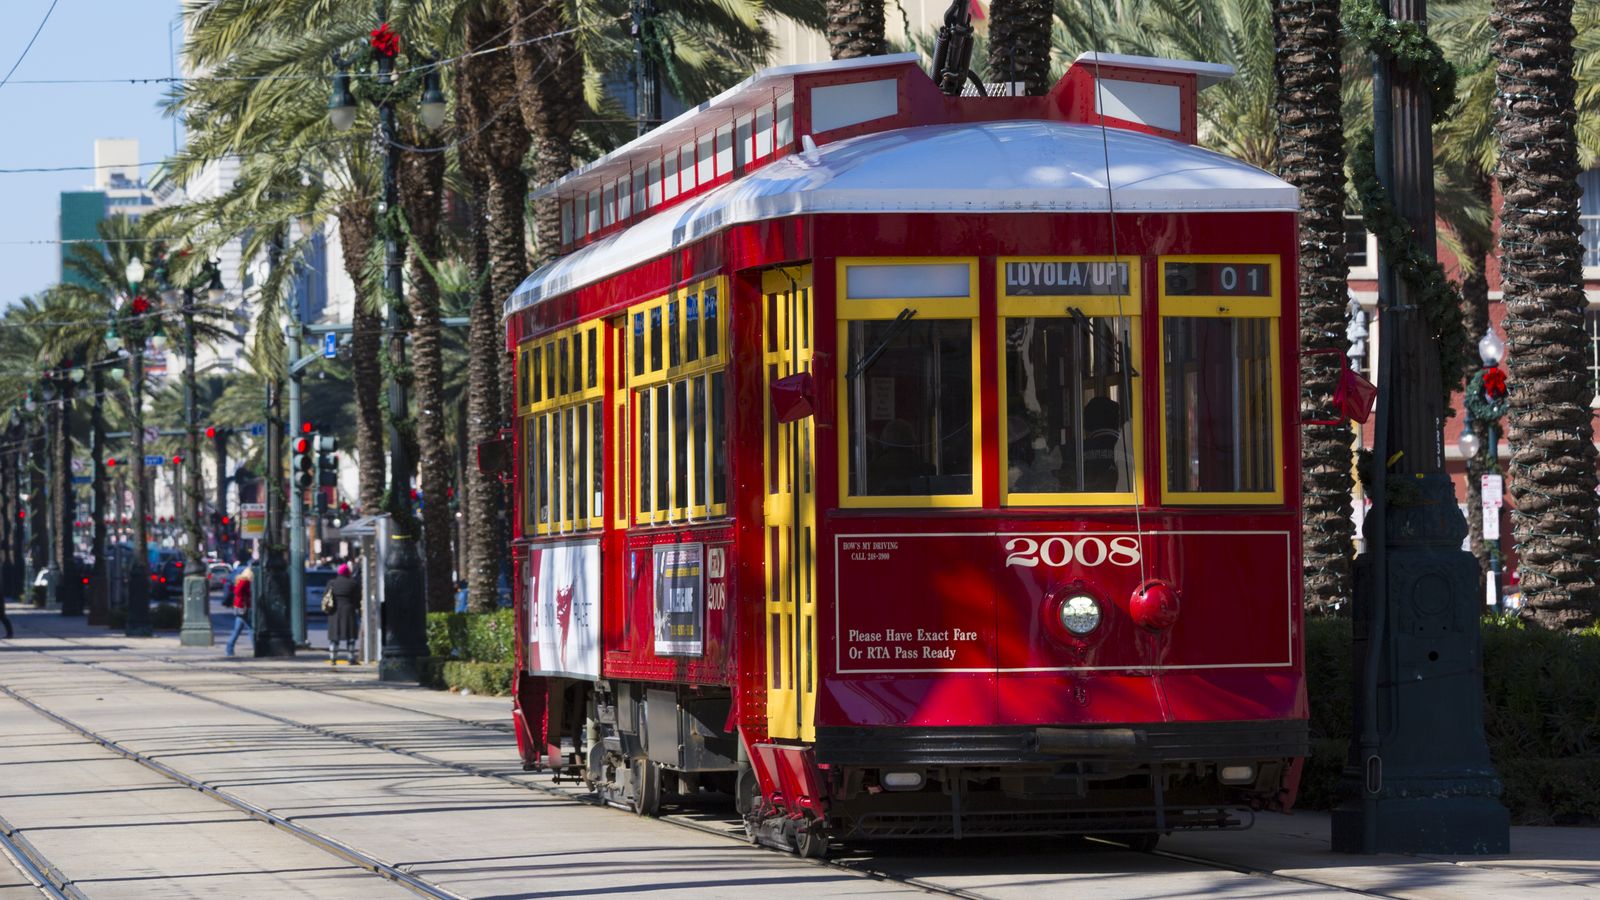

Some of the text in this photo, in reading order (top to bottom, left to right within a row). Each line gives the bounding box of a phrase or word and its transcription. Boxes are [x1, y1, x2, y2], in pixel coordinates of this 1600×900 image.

[843, 541, 898, 550] HOW'S MY DRIVING
[1005, 536, 1141, 568] 2008
[851, 552, 866, 560] CALL
[848, 628, 977, 642] Please Have Exact Fare
[849, 646, 956, 660] Or RTA Pass Ready
